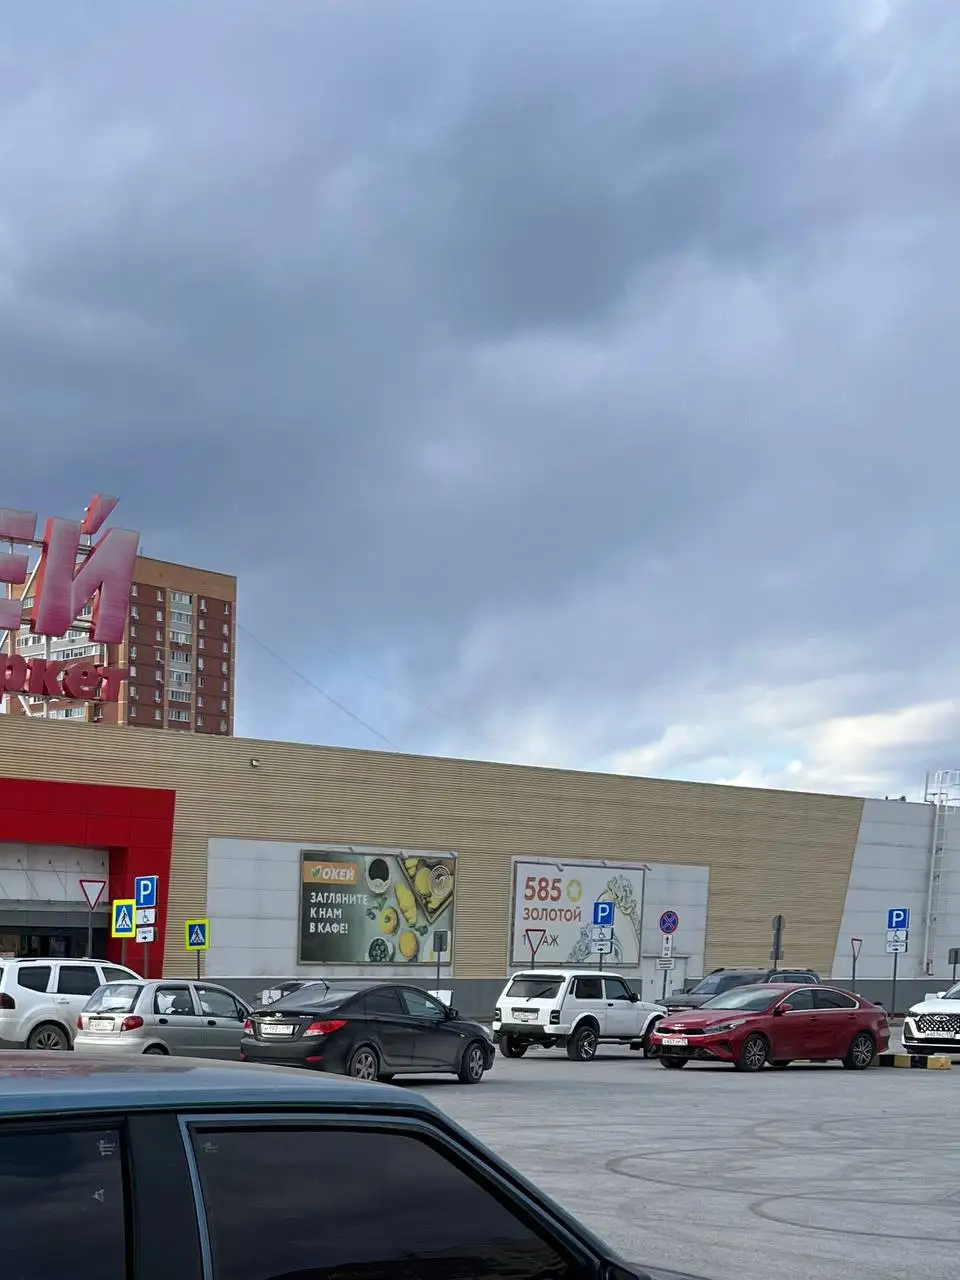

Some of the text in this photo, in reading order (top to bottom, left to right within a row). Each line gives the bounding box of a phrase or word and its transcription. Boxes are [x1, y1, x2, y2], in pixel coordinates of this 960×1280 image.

[140, 880, 152, 904] P
[524, 876, 562, 902] 585
[310, 892, 369, 905] ЗАГЛЯНИТЕ
[310, 907, 342, 919] К НАМ
[523, 906, 582, 922] ЗОЛОТОЙ
[597, 904, 610, 923] P
[892, 910, 904, 927] P
[309, 922, 349, 934] В КАФЕ!
